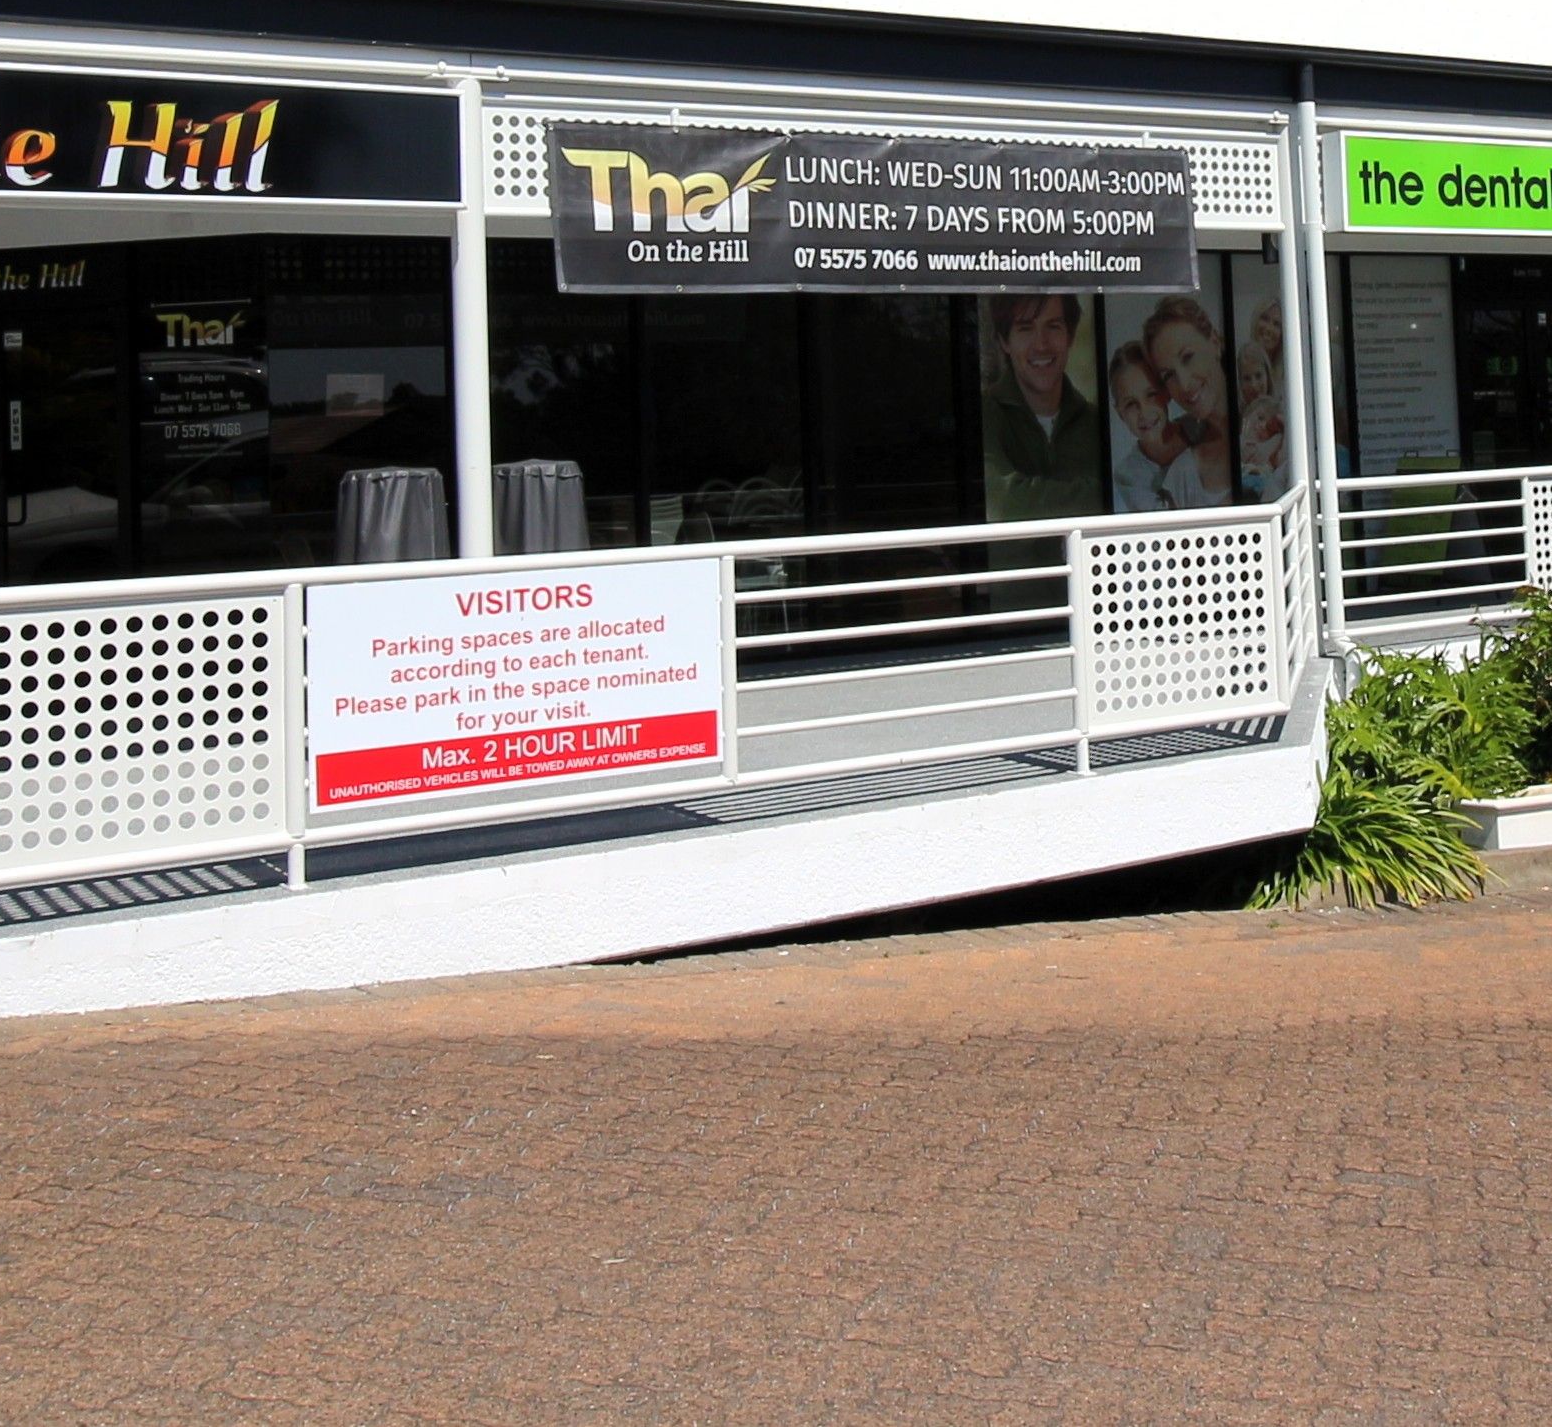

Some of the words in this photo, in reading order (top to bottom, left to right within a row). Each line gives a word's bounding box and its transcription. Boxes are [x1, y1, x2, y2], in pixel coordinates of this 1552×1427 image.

[98, 99, 280, 192] Hill
[561, 147, 777, 233] Thai
[784, 155, 881, 187] LUNCH:
[886, 159, 1003, 191] WED-SUN
[1009, 165, 1186, 197] 11:00AM-3:00PM
[1359, 160, 1424, 206] the
[788, 199, 898, 231] DINNER:
[905, 204, 919, 230] 7
[926, 206, 990, 233] DAYS
[997, 207, 1066, 236] FROM
[1072, 210, 1155, 237] 5:00PM
[627, 239, 661, 263] On
[666, 239, 703, 263] the
[707, 240, 750, 263] Hill
[794, 247, 815, 269] 07
[819, 247, 867, 270] 5575
[871, 248, 919, 271] 7066
[927, 248, 1142, 273] www.thaionthehill.com
[39, 259, 86, 289] Hill
[156, 310, 247, 348] Thai
[164, 425, 178, 440] 07
[181, 423, 211, 439] 5575
[455, 583, 594, 617] VISITORS
[372, 633, 454, 659] Parking
[460, 628, 534, 654] spaces
[539, 625, 571, 644] are
[577, 614, 666, 640] allocated
[390, 655, 496, 685] according
[502, 653, 524, 674] to
[529, 648, 577, 671] each
[582, 643, 650, 666] tenant.
[335, 691, 408, 718] Please
[414, 687, 462, 714] park
[467, 684, 486, 704] in
[493, 679, 525, 702] the
[531, 676, 591, 701] space
[596, 662, 699, 692] nominated
[456, 709, 485, 733] for
[491, 707, 538, 733] your
[544, 699, 592, 721] visit.
[422, 745, 476, 771] Max.
[483, 739, 498, 763] 2
[504, 730, 575, 760] HOUR
[581, 723, 643, 752] LIMIT
[329, 776, 422, 800] UNAUTHORISED
[423, 768, 479, 789] VEHICLES
[479, 764, 506, 781] WILL
[506, 762, 523, 778] BE
[524, 758, 566, 777] TOWED
[566, 754, 596, 772] AWAY
[596, 752, 610, 768] AT
[610, 746, 659, 766] OWNERS
[658, 741, 707, 760] EXPENSE
